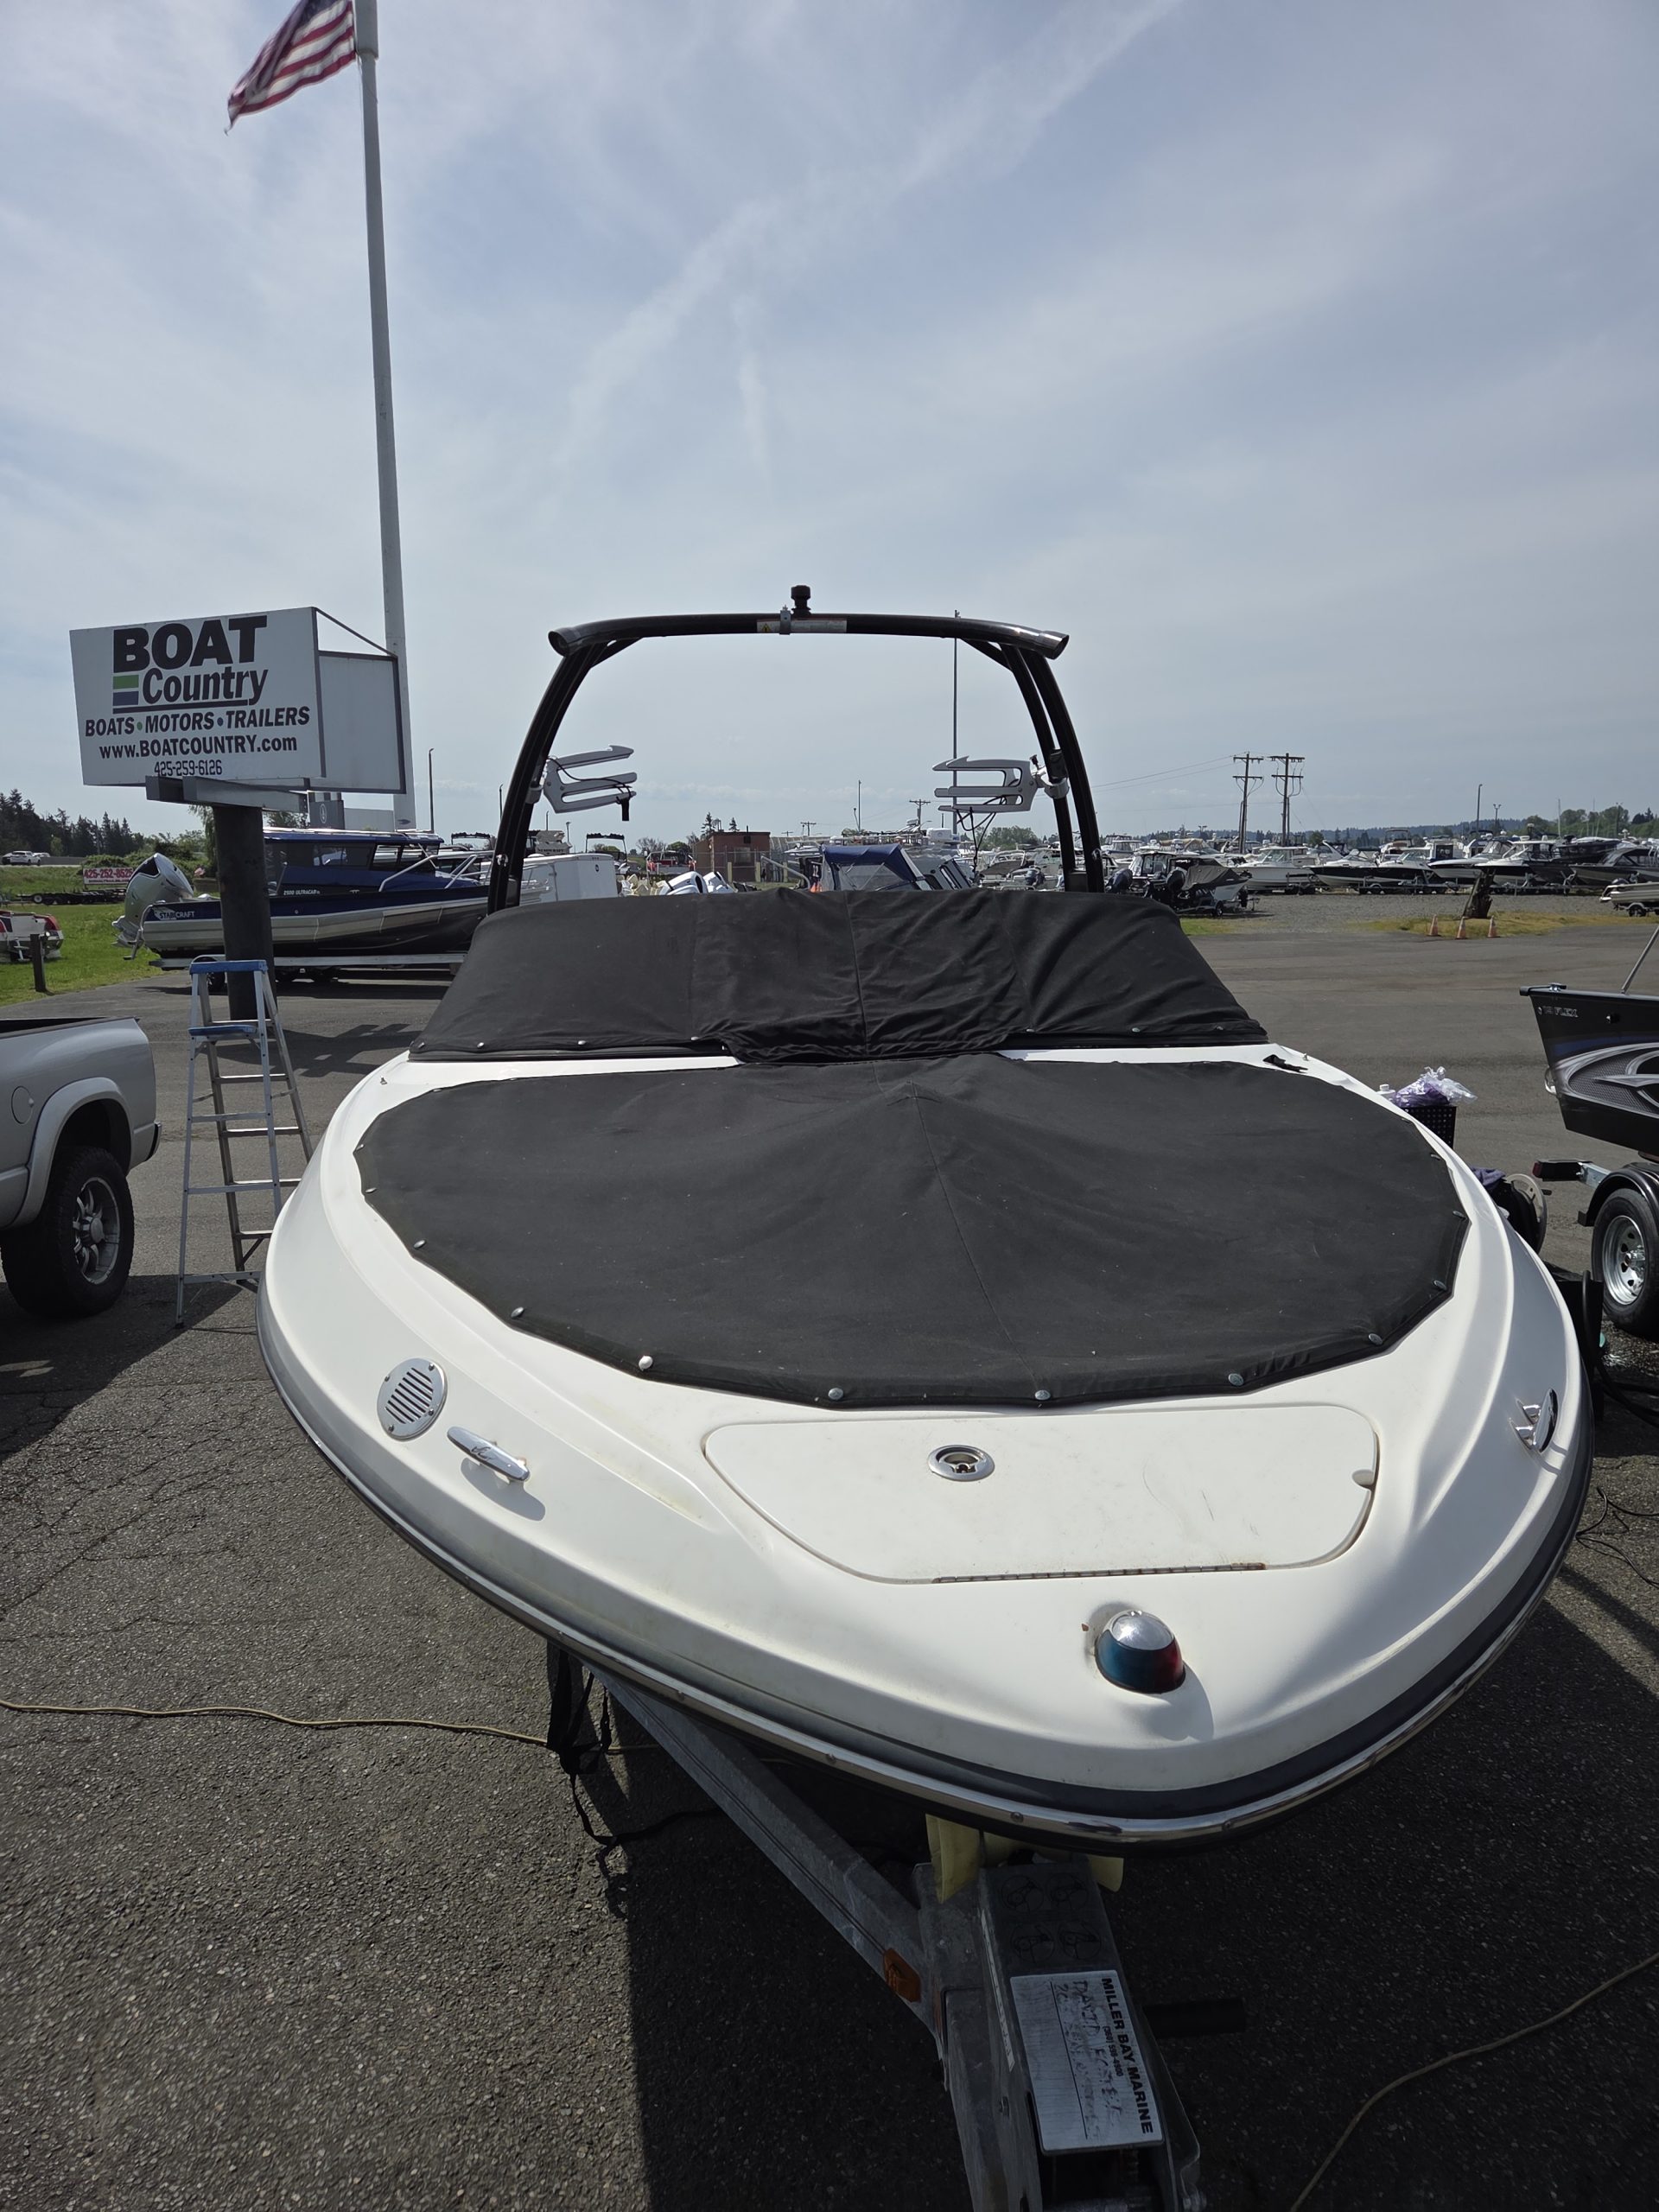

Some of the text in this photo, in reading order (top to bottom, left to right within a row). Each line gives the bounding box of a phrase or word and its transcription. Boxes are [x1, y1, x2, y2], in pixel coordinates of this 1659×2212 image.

[113, 614, 268, 673] BOAT
[142, 666, 269, 706] Country
[86, 706, 310, 737] BOATS MOTORS TRAILERS
[99, 734, 297, 760] www.BOATCOUNTRY.com
[154, 759, 222, 777] 425-259-6126
[1102, 1978, 1154, 2133] MILLER BAY MARINE
